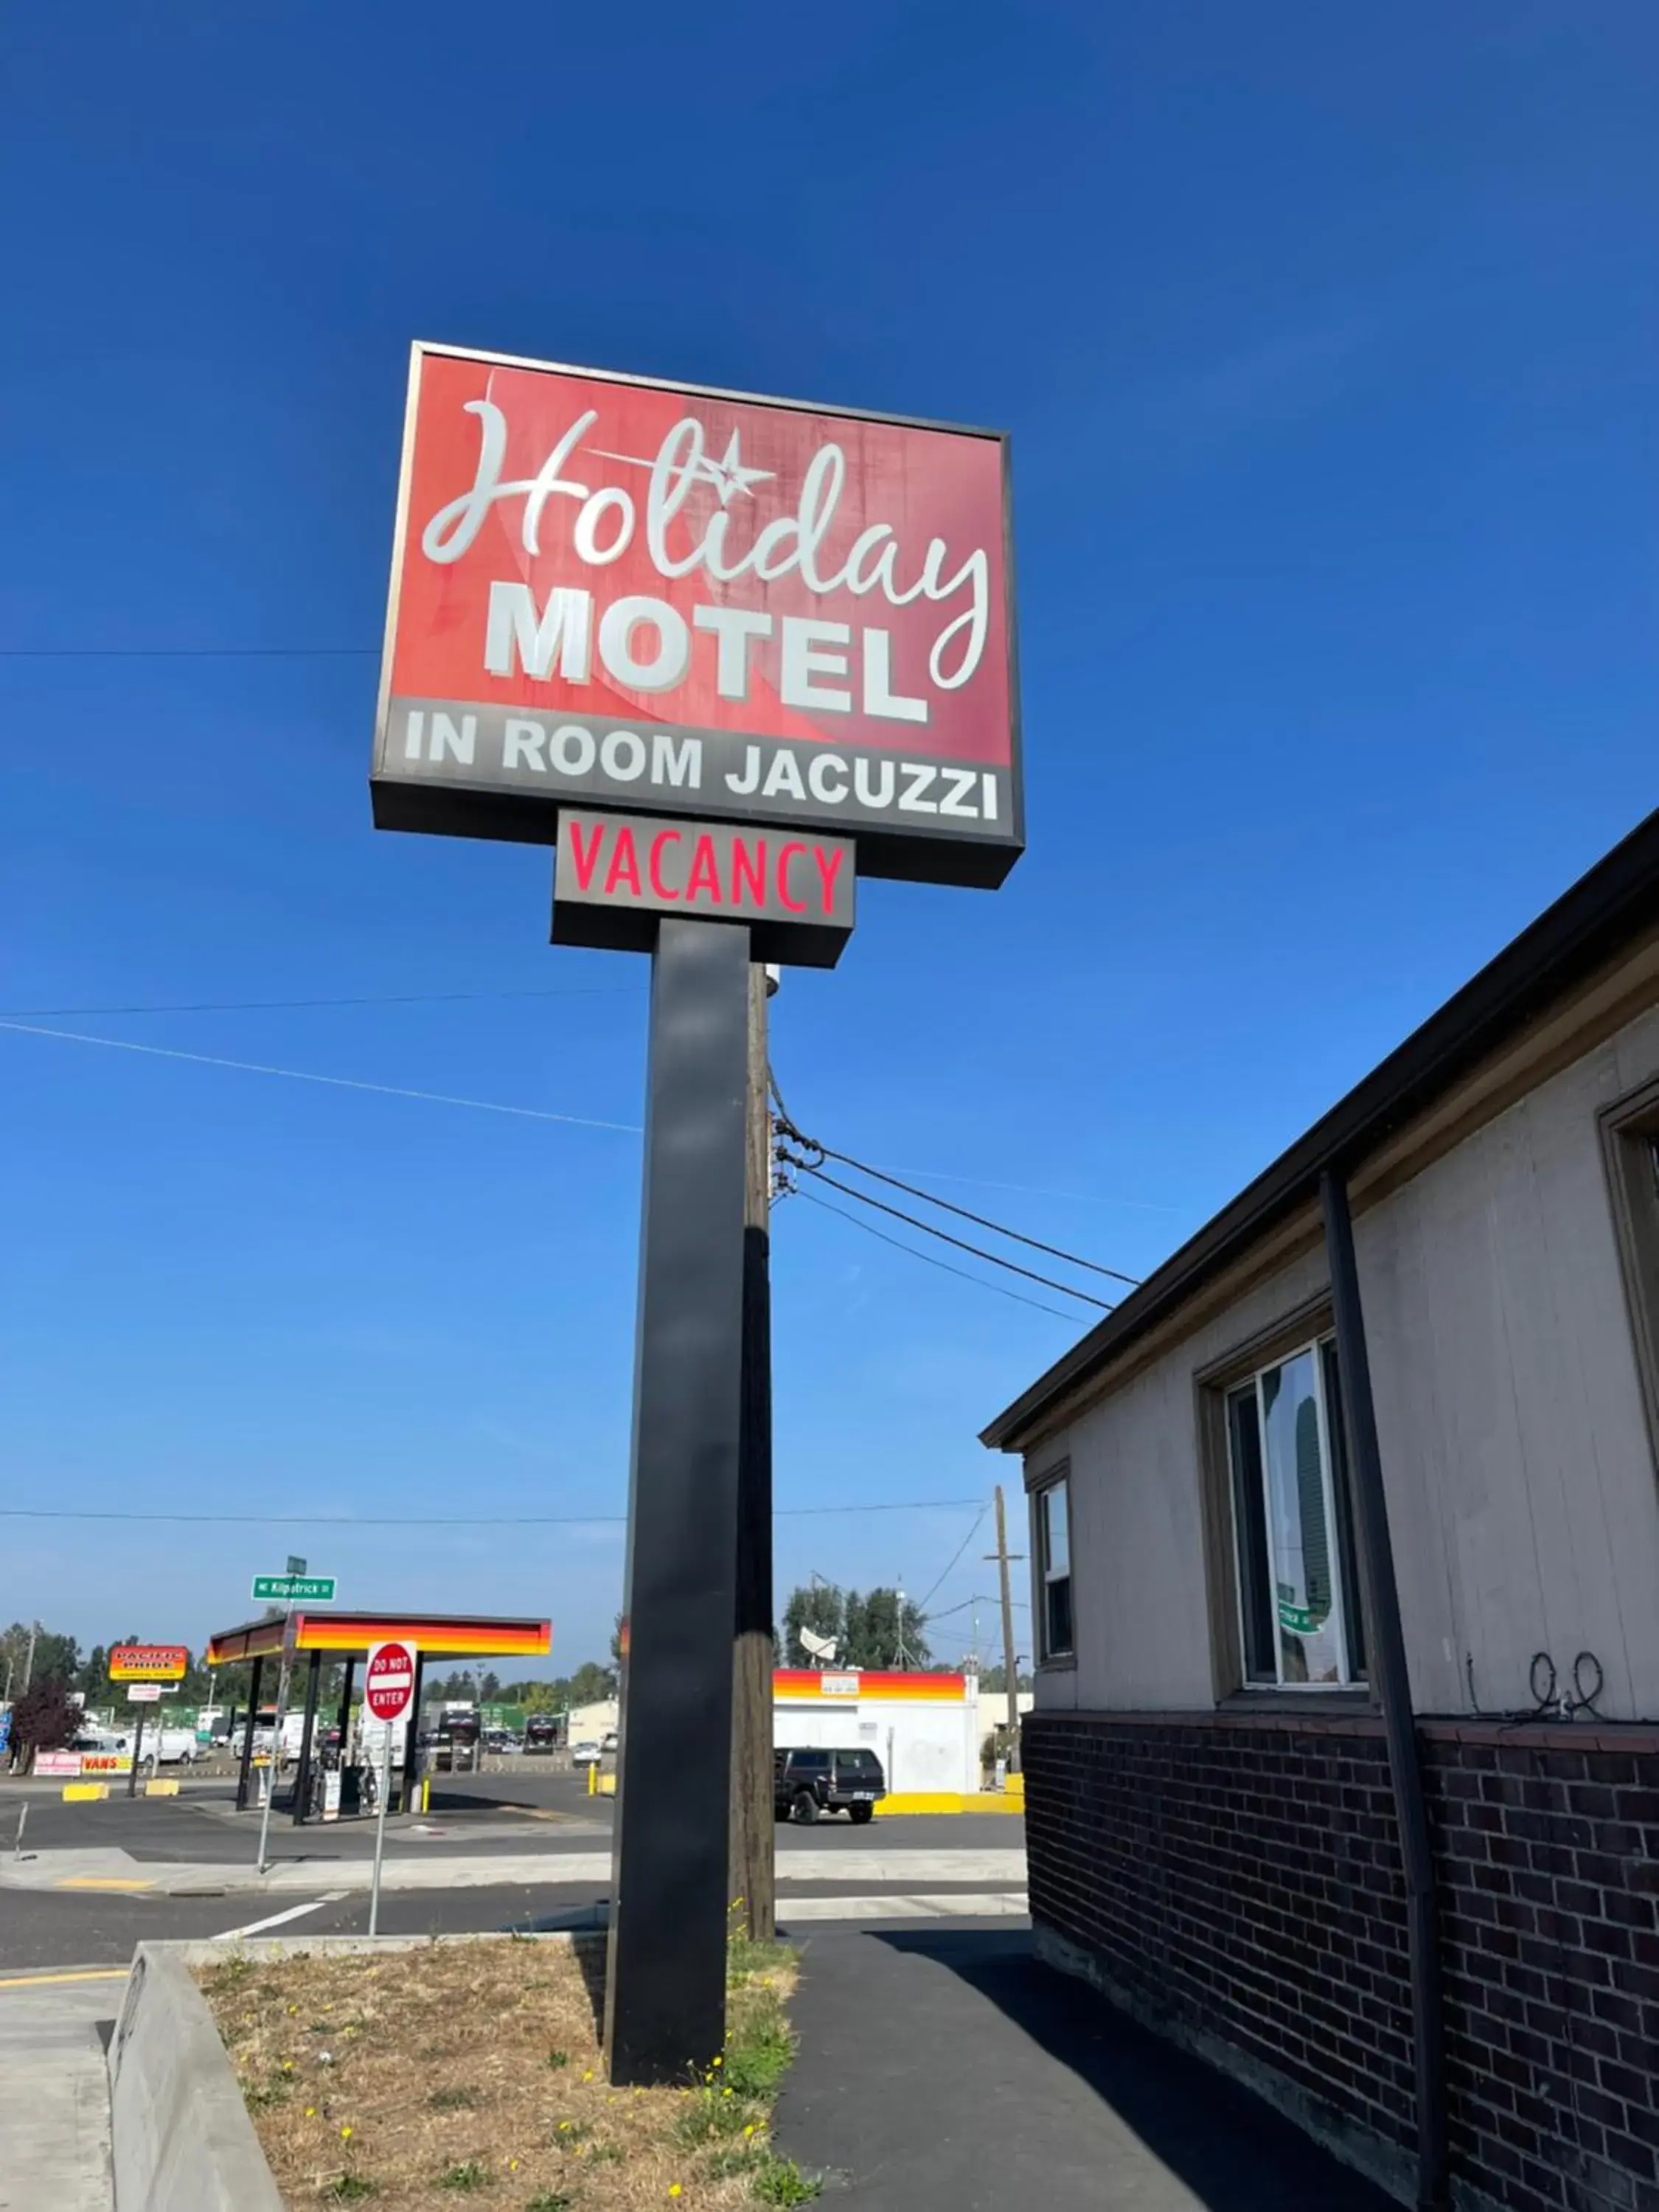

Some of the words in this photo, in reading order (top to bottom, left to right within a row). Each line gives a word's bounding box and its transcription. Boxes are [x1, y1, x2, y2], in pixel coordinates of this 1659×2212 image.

[422, 399, 988, 689] Holiday
[484, 580, 928, 723] MOTEL
[404, 710, 476, 765] IN
[502, 720, 701, 789] ROOM
[725, 745, 998, 820] JACUZZI
[568, 821, 844, 914] VACANCY
[372, 1691, 403, 1707] ENTER
[374, 1658, 387, 1672] DO
[389, 1656, 408, 1671] NOT
[84, 1757, 117, 1770] VANS
